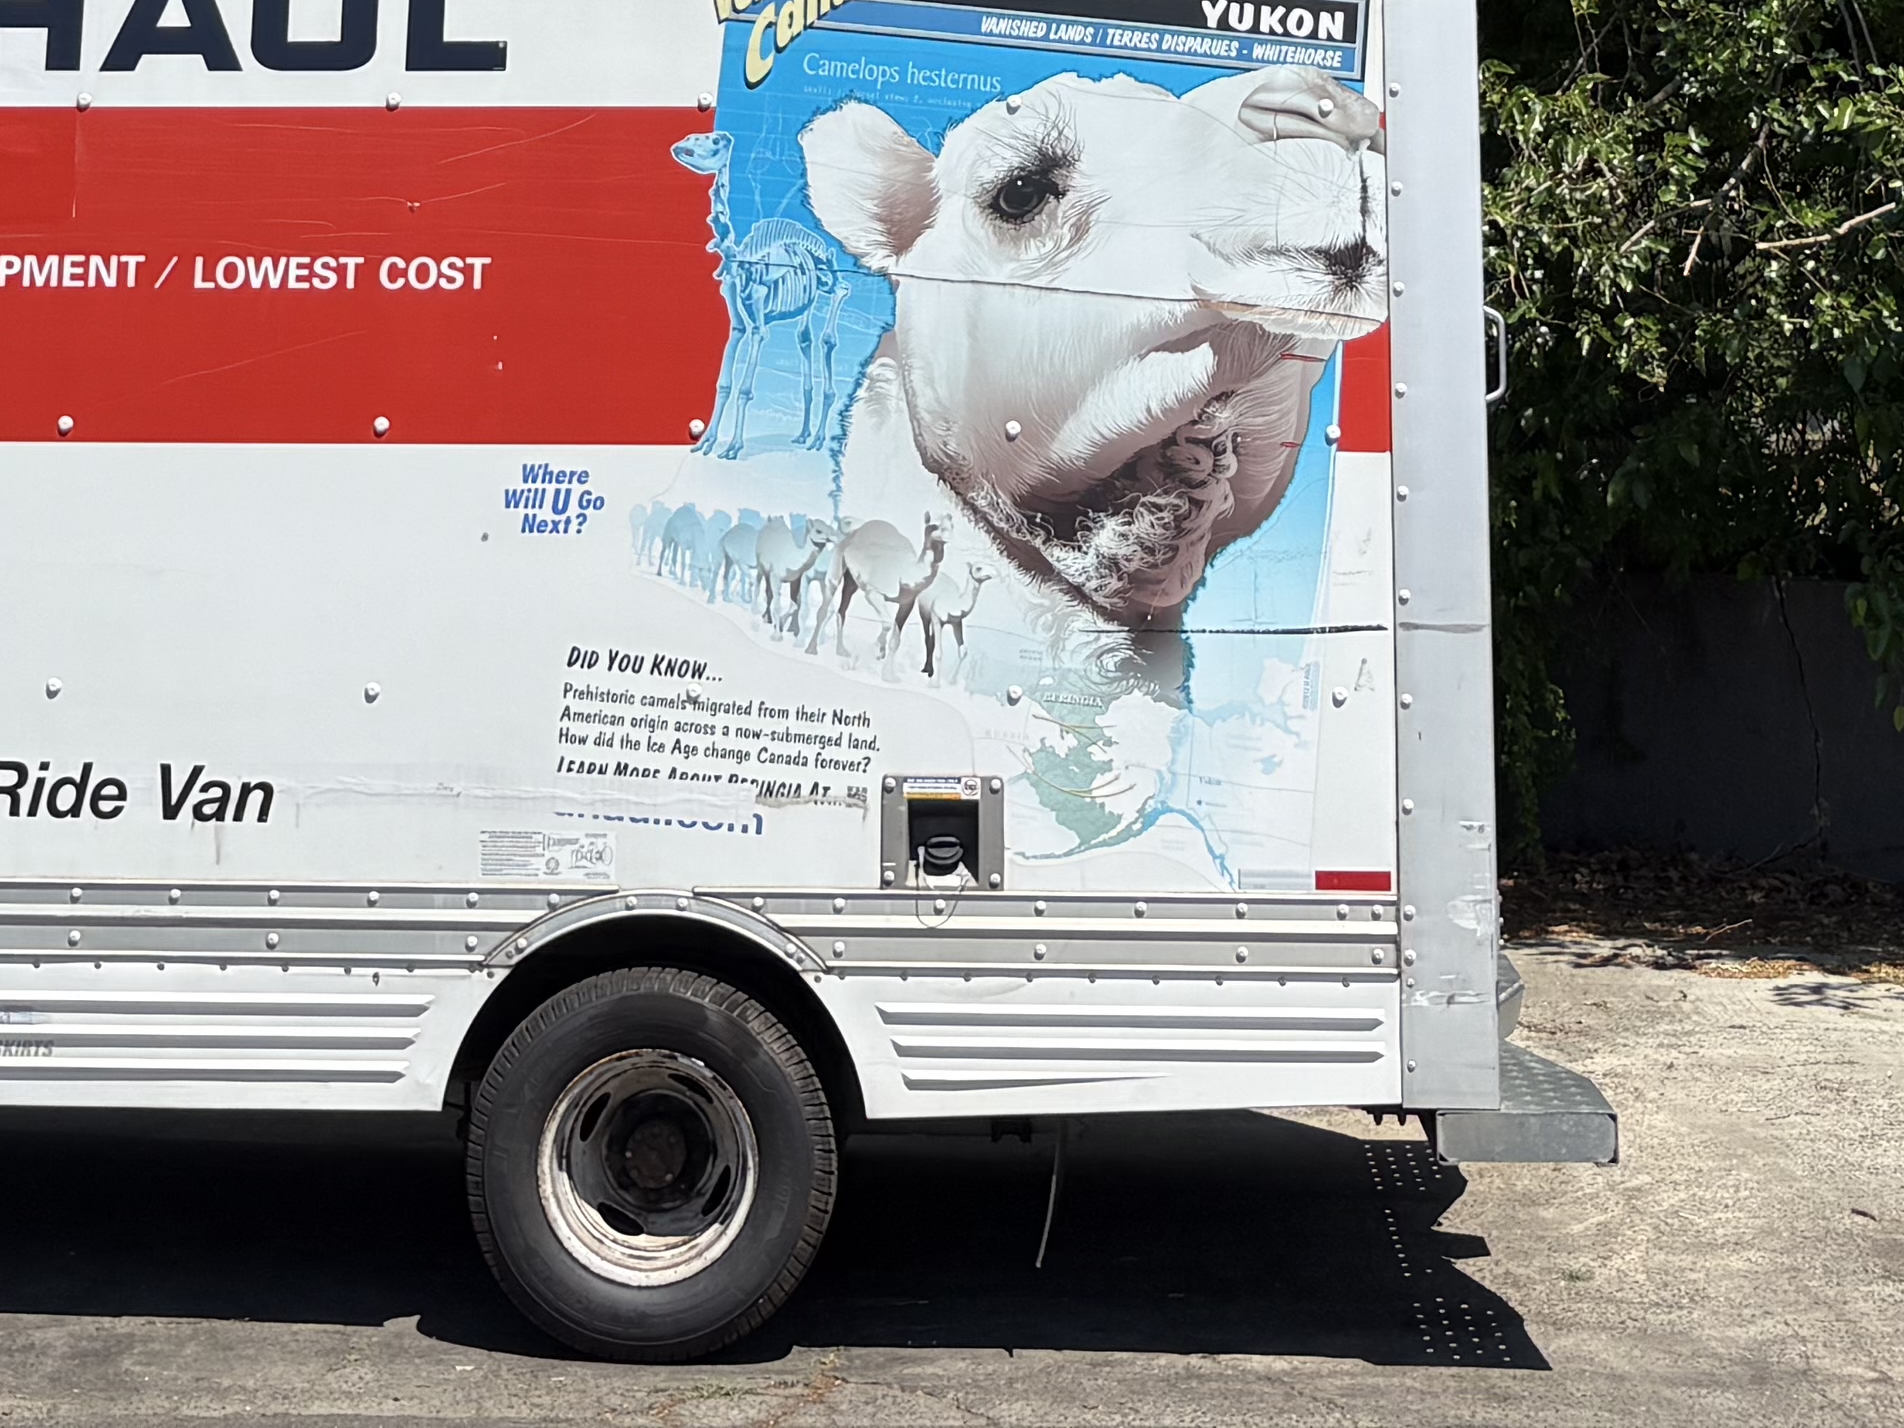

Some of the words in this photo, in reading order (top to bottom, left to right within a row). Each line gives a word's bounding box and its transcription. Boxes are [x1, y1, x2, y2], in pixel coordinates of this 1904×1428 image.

[981, 15, 1047, 38] VANISHED
[1049, 22, 1095, 44] LANDS
[1106, 29, 1160, 50] TERRES
[1162, 34, 1240, 58] DISPARUES
[1252, 42, 1344, 68] WHITEHORSE
[802, 52, 900, 90] Camelops
[906, 61, 1002, 93] hesternus
[194, 256, 366, 291] LOWEST
[378, 256, 493, 291] COST
[522, 463, 590, 485] Where
[504, 488, 546, 509] Will
[551, 488, 573, 515] U
[578, 489, 605, 510] Go
[567, 645, 600, 670] DID
[607, 648, 645, 674] YOU
[563, 682, 636, 705] Prehistoric
[640, 693, 687, 711] camels
[693, 696, 753, 717] migrated
[758, 700, 790, 720] from
[795, 704, 827, 724] their
[831, 708, 871, 728] North
[559, 705, 625, 727] American
[630, 714, 669, 734] origin
[674, 721, 716, 736] across
[721, 725, 730, 737] a
[735, 726, 843, 750] now-submerged
[847, 732, 881, 752] land.
[558, 727, 589, 746] How
[593, 731, 615, 748] did
[620, 733, 641, 751] the
[646, 735, 665, 753] Ice
[671, 738, 699, 760] Age
[704, 741, 751, 765] change
[757, 746, 809, 767] Canada
[814, 751, 872, 774] forever?
[158, 762, 276, 826] Van
